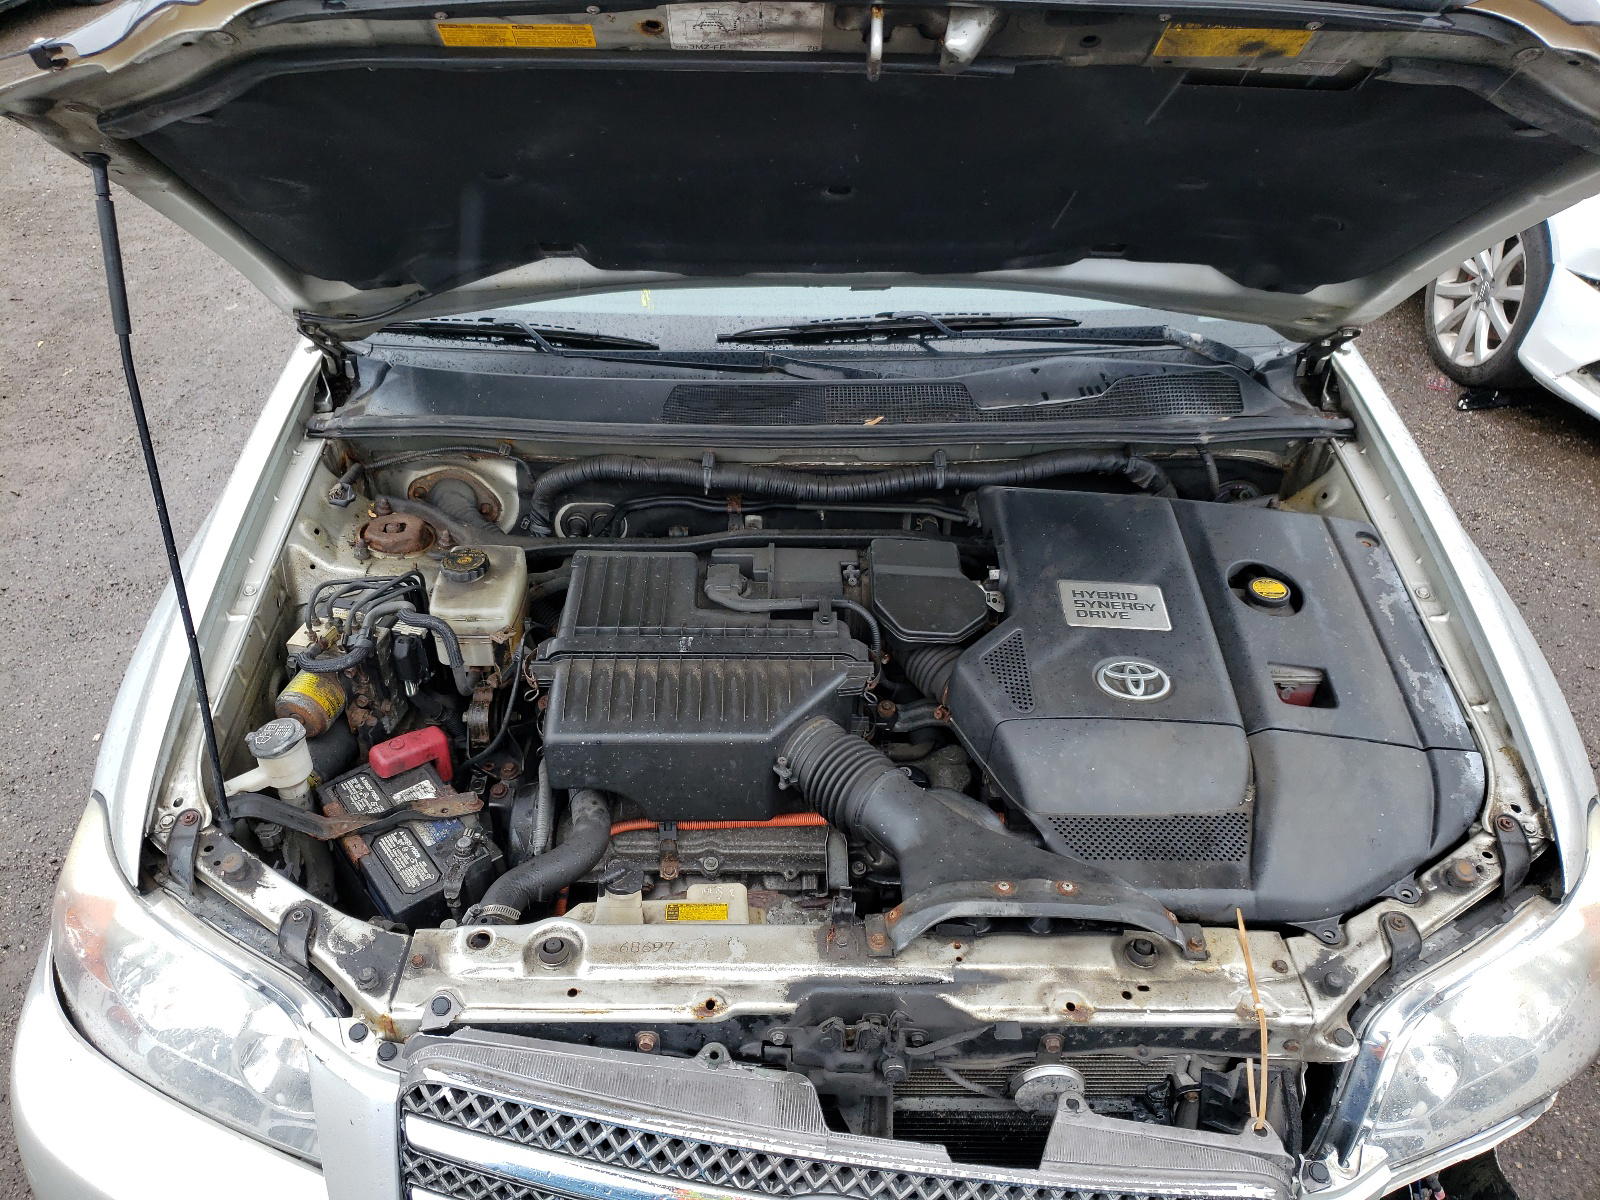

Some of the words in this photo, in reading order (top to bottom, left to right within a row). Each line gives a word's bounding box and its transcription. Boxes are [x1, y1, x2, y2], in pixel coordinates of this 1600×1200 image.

[1072, 590, 1138, 600] HYBRID
[1074, 600, 1156, 611] SYNERGY
[1076, 610, 1131, 619] DRIVE
